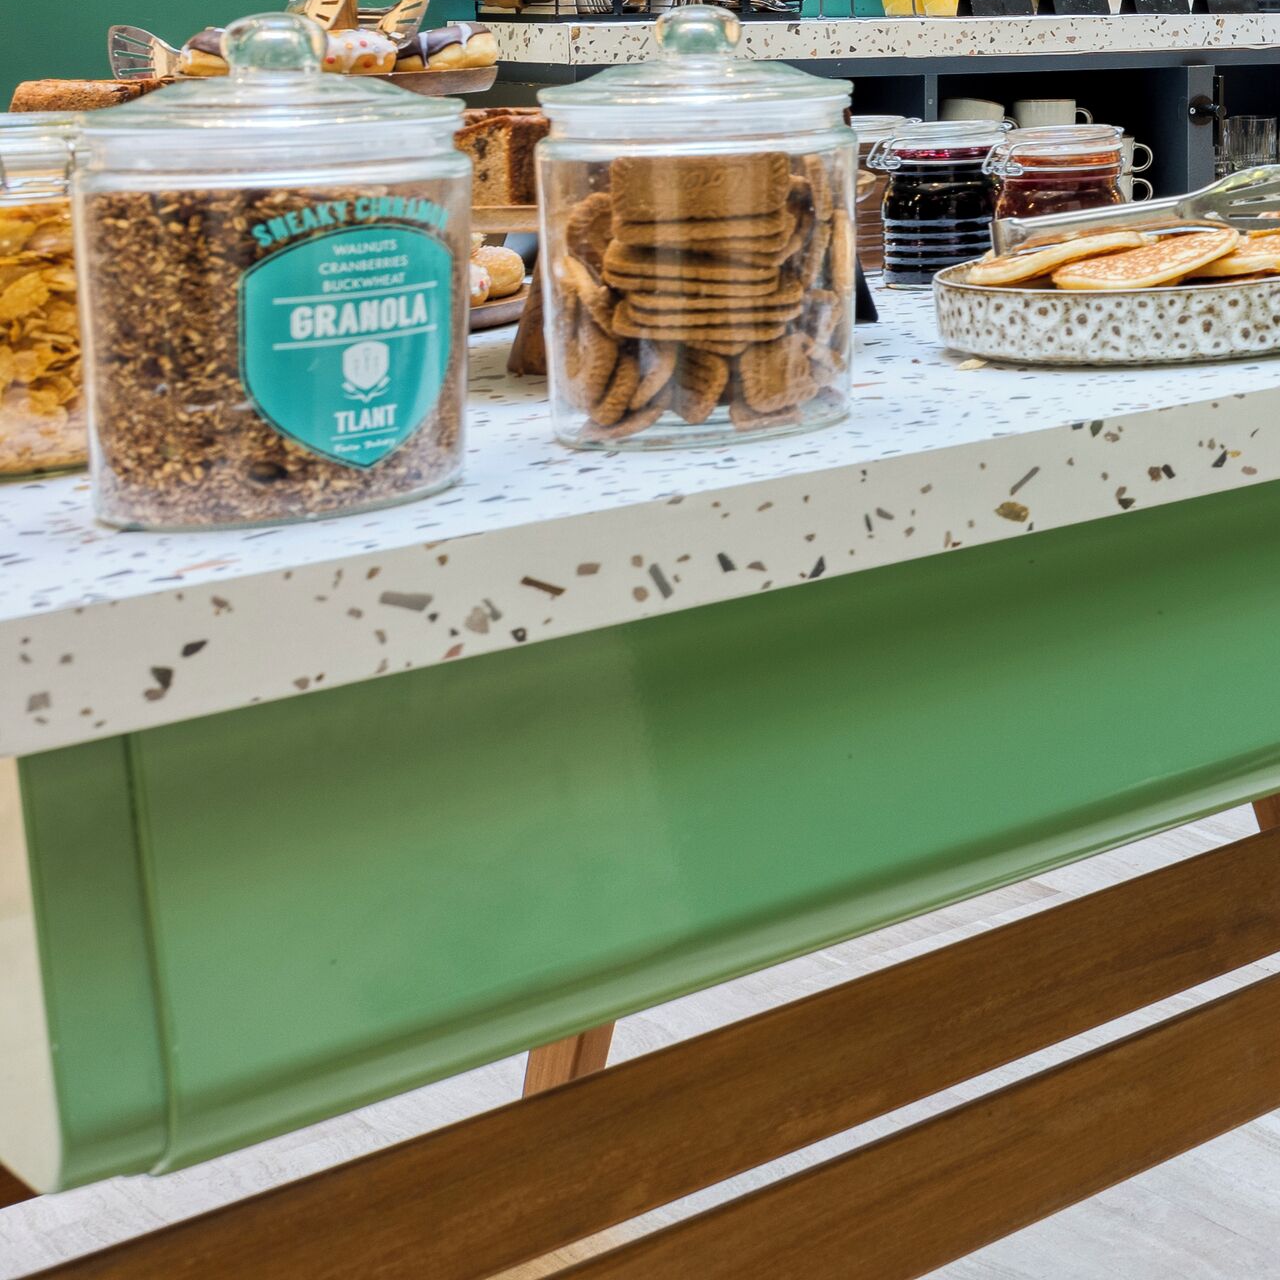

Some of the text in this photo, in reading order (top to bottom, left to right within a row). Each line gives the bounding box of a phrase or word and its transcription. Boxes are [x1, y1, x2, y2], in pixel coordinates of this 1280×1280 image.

[252, 199, 348, 248] SNEAKY
[331, 238, 399, 257] WALNUTS
[318, 254, 410, 276] CRANBERRIES
[322, 272, 406, 293] BUCKWHEAT
[289, 293, 429, 340] GRANOLA
[333, 403, 398, 434] TLANT
